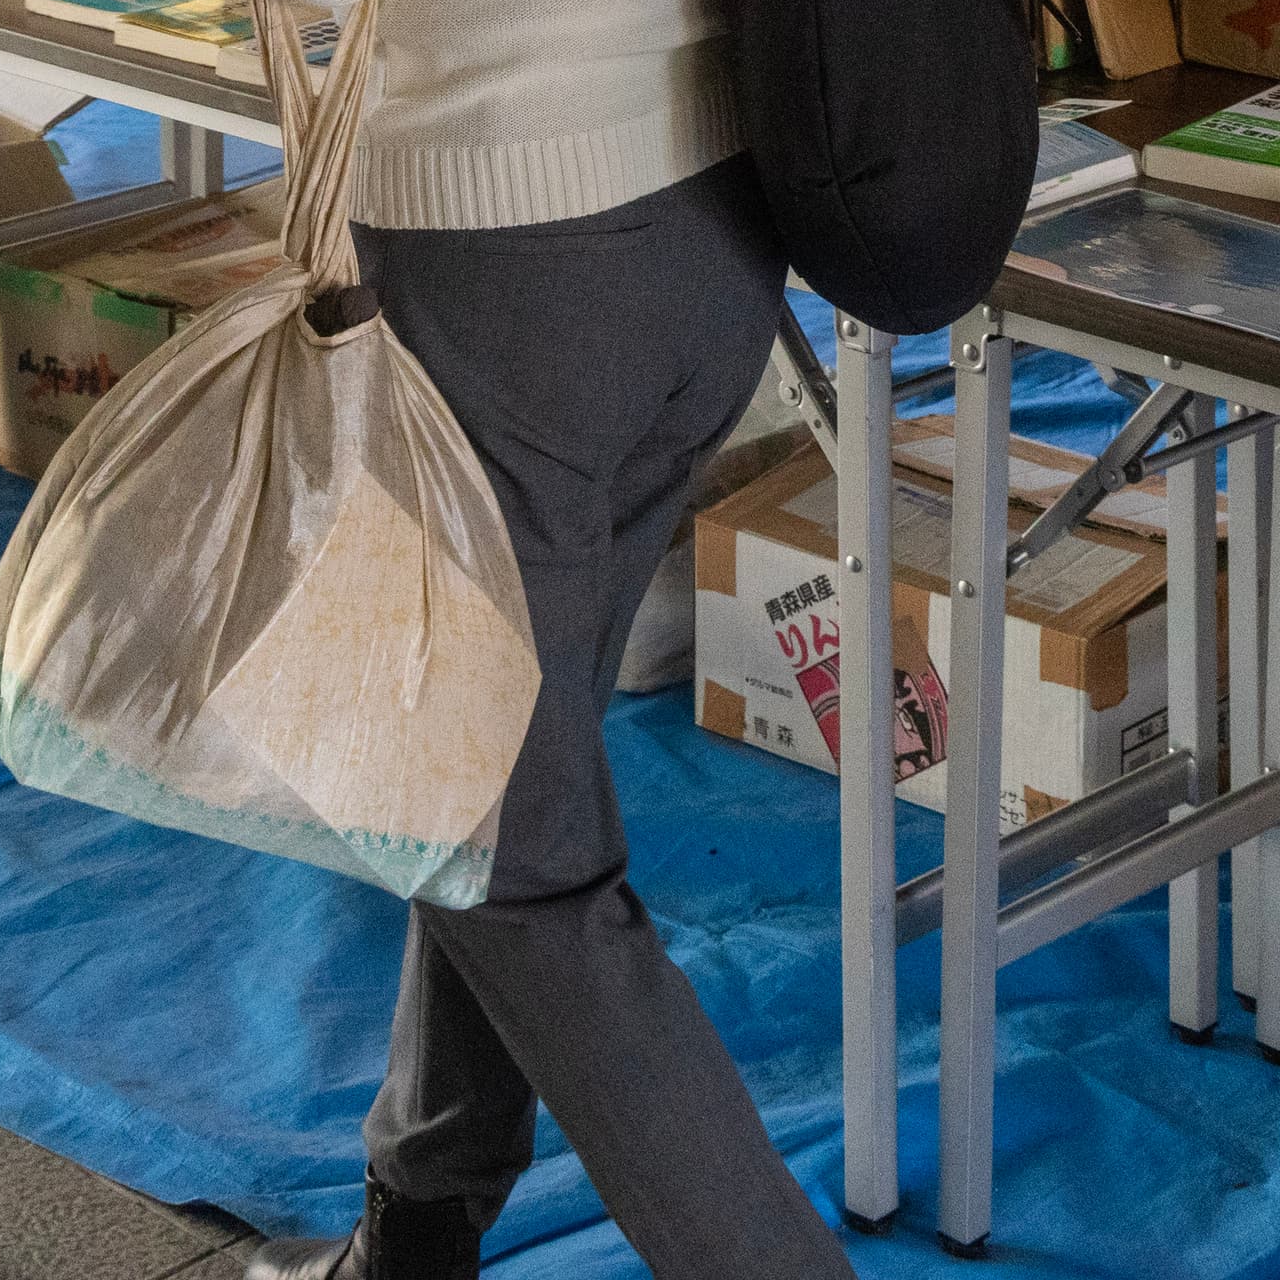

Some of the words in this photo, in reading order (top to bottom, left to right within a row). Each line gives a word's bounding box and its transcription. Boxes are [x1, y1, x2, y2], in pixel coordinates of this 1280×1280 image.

[764, 573, 836, 626] 青森県産
[754, 715, 794, 748] 青森
